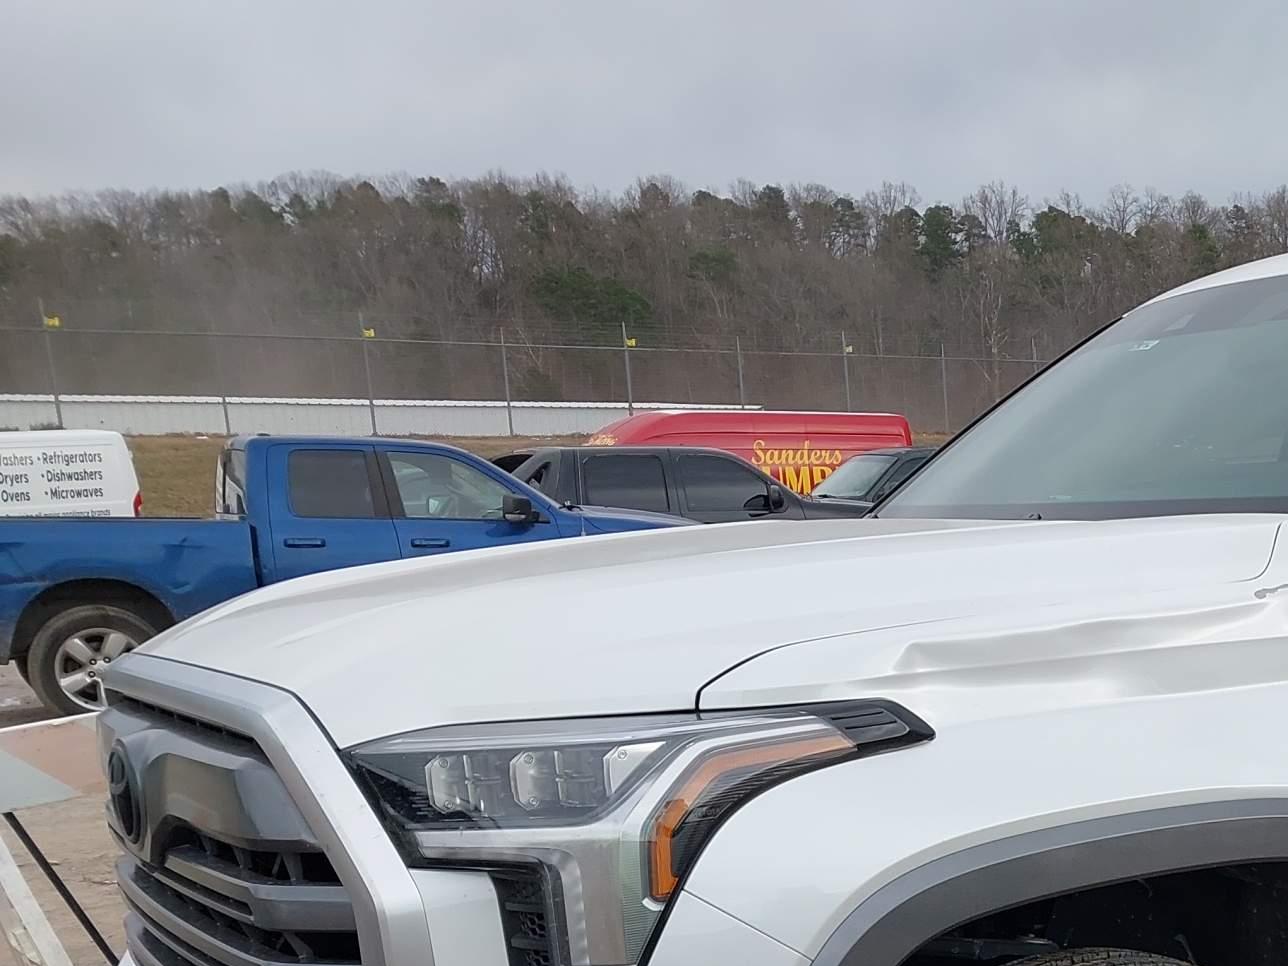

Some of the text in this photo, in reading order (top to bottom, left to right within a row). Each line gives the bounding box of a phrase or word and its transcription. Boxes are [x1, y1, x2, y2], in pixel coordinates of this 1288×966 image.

[42, 451, 103, 467] Refrigerators
[751, 439, 842, 465] Sanders
[0, 454, 34, 467] ashers
[46, 468, 103, 483] Dishwashers
[1, 489, 31, 503] Ovens
[50, 487, 104, 501] Microwaves
